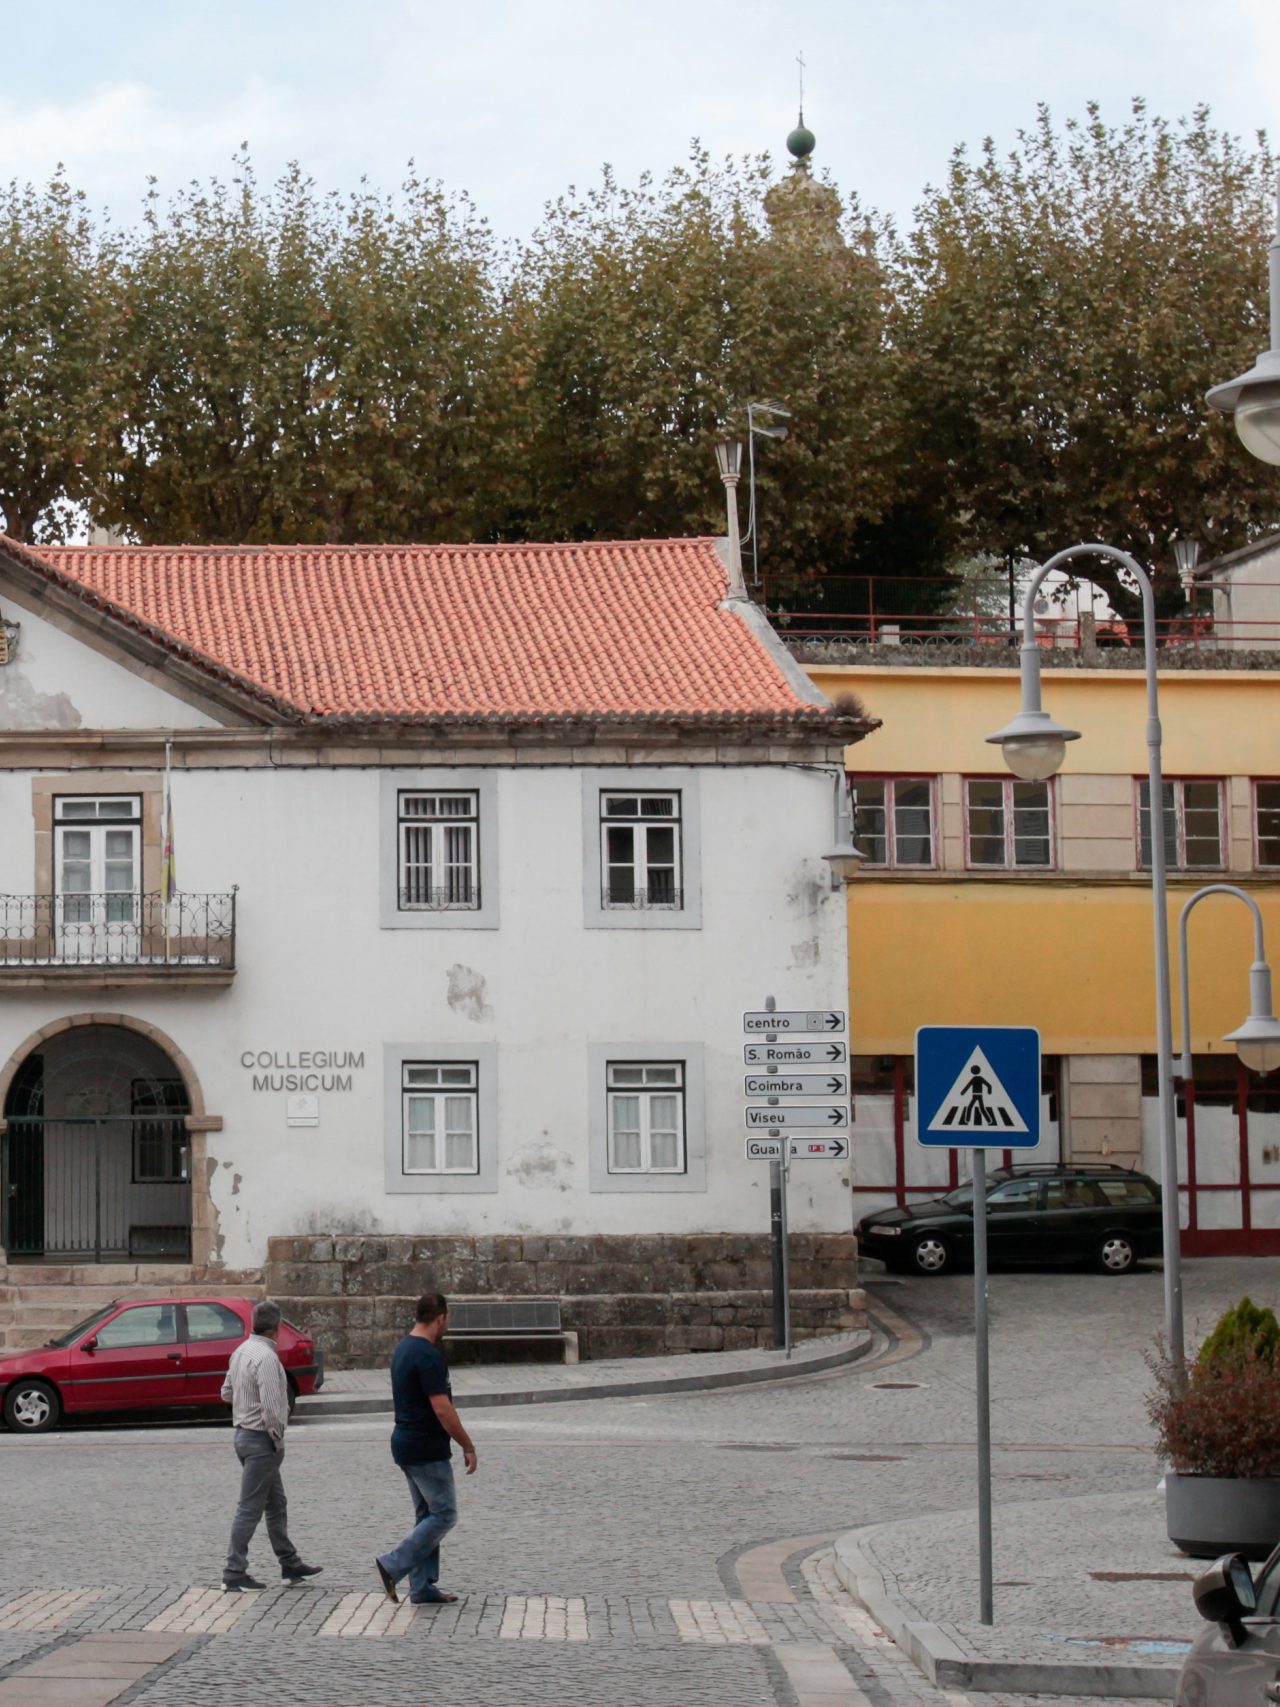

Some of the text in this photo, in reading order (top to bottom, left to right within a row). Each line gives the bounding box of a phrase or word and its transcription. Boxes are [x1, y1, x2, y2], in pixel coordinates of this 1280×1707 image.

[747, 1017, 790, 1028] centro
[240, 1051, 365, 1069] COLLEGIUM
[748, 1048, 811, 1060] S. Romão
[252, 1074, 353, 1092] MUSICUM
[748, 1080, 803, 1092] Coimbra
[750, 1112, 786, 1123] Viseu
[750, 1143, 797, 1155] Guaa
